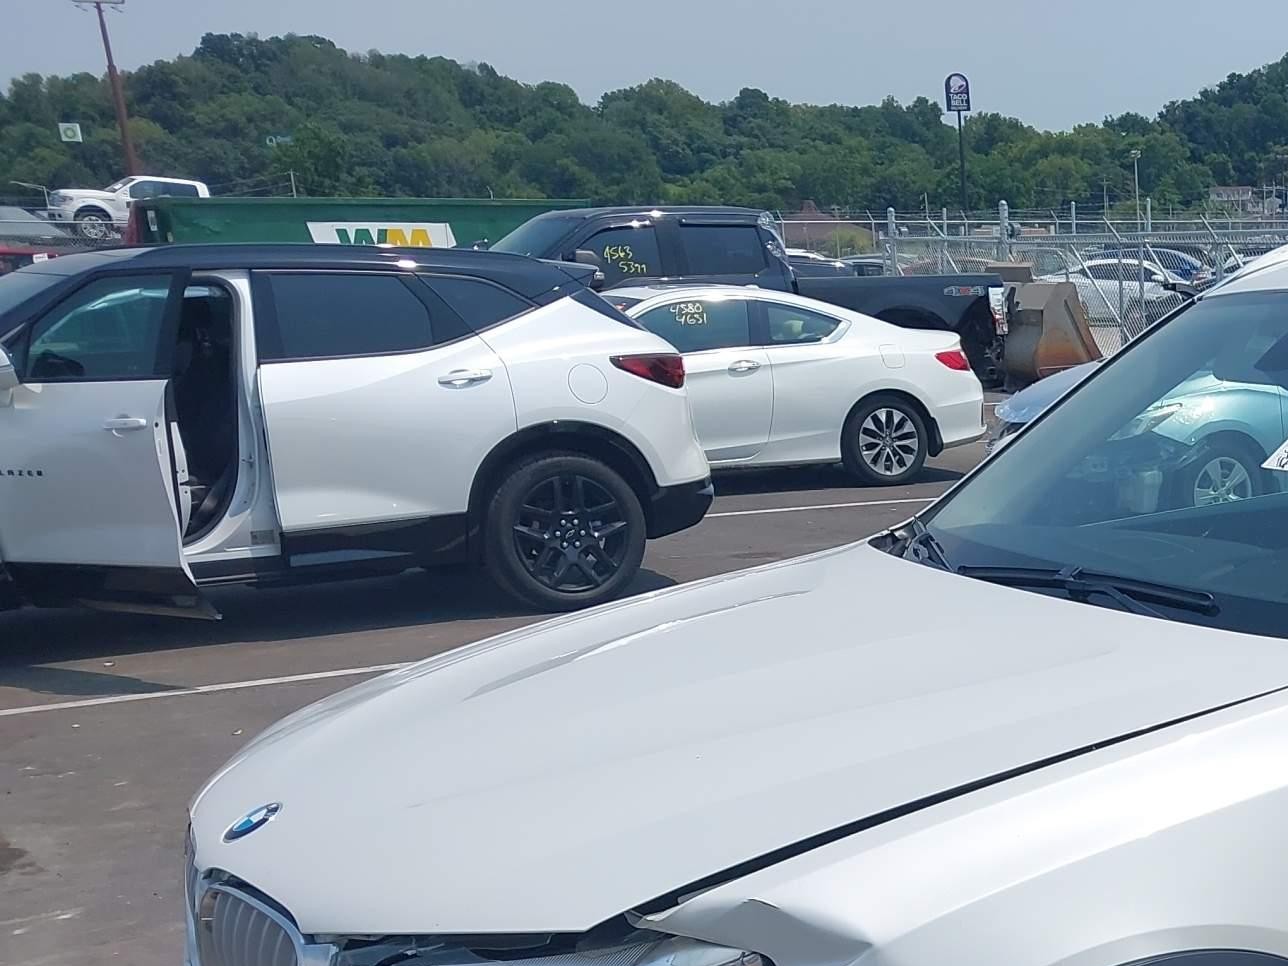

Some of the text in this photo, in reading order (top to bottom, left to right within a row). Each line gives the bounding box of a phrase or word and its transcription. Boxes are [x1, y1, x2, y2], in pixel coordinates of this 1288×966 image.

[335, 227, 433, 248] WM
[603, 245, 633, 264] 4563
[669, 302, 703, 316] 4580
[675, 312, 707, 326] 4651
